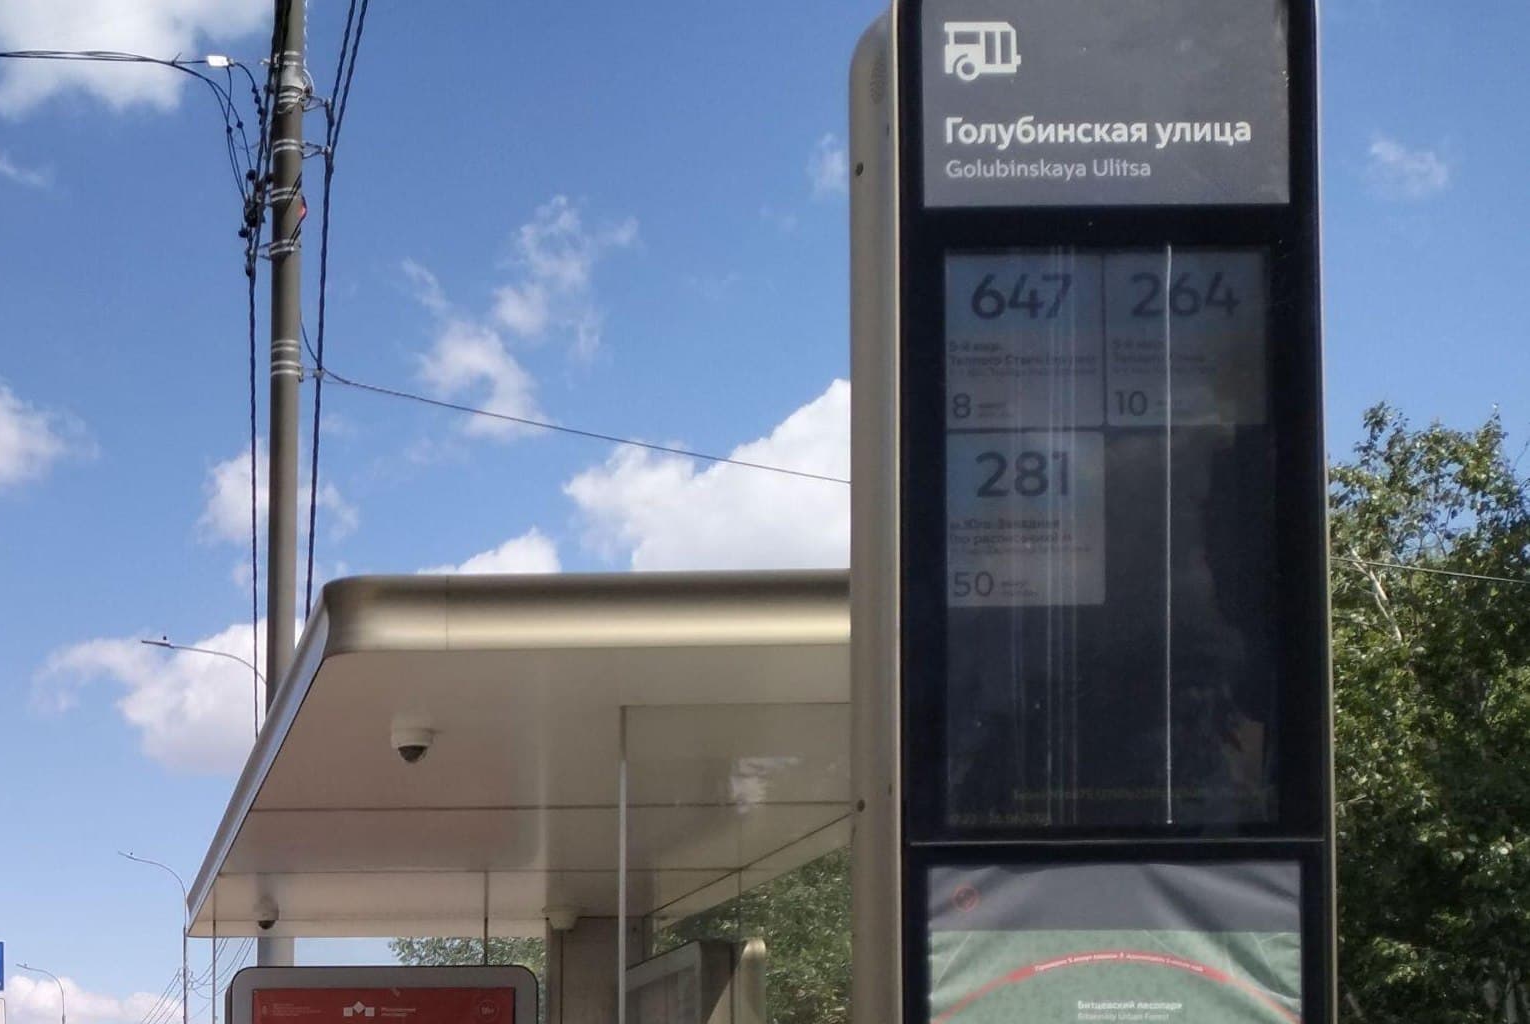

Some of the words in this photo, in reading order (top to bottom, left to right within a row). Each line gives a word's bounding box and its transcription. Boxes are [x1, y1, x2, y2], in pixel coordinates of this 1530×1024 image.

[944, 116, 1148, 151] Голубинская
[1155, 119, 1253, 148] улица
[945, 158, 1087, 181] Golubinskaya
[1092, 158, 1152, 178] Ulitsa
[971, 273, 1072, 320] 647
[1130, 271, 1240, 317] 264
[952, 392, 971, 419] 8
[1115, 390, 1149, 417] 10
[975, 451, 1069, 498] 281
[953, 571, 995, 598] 50
